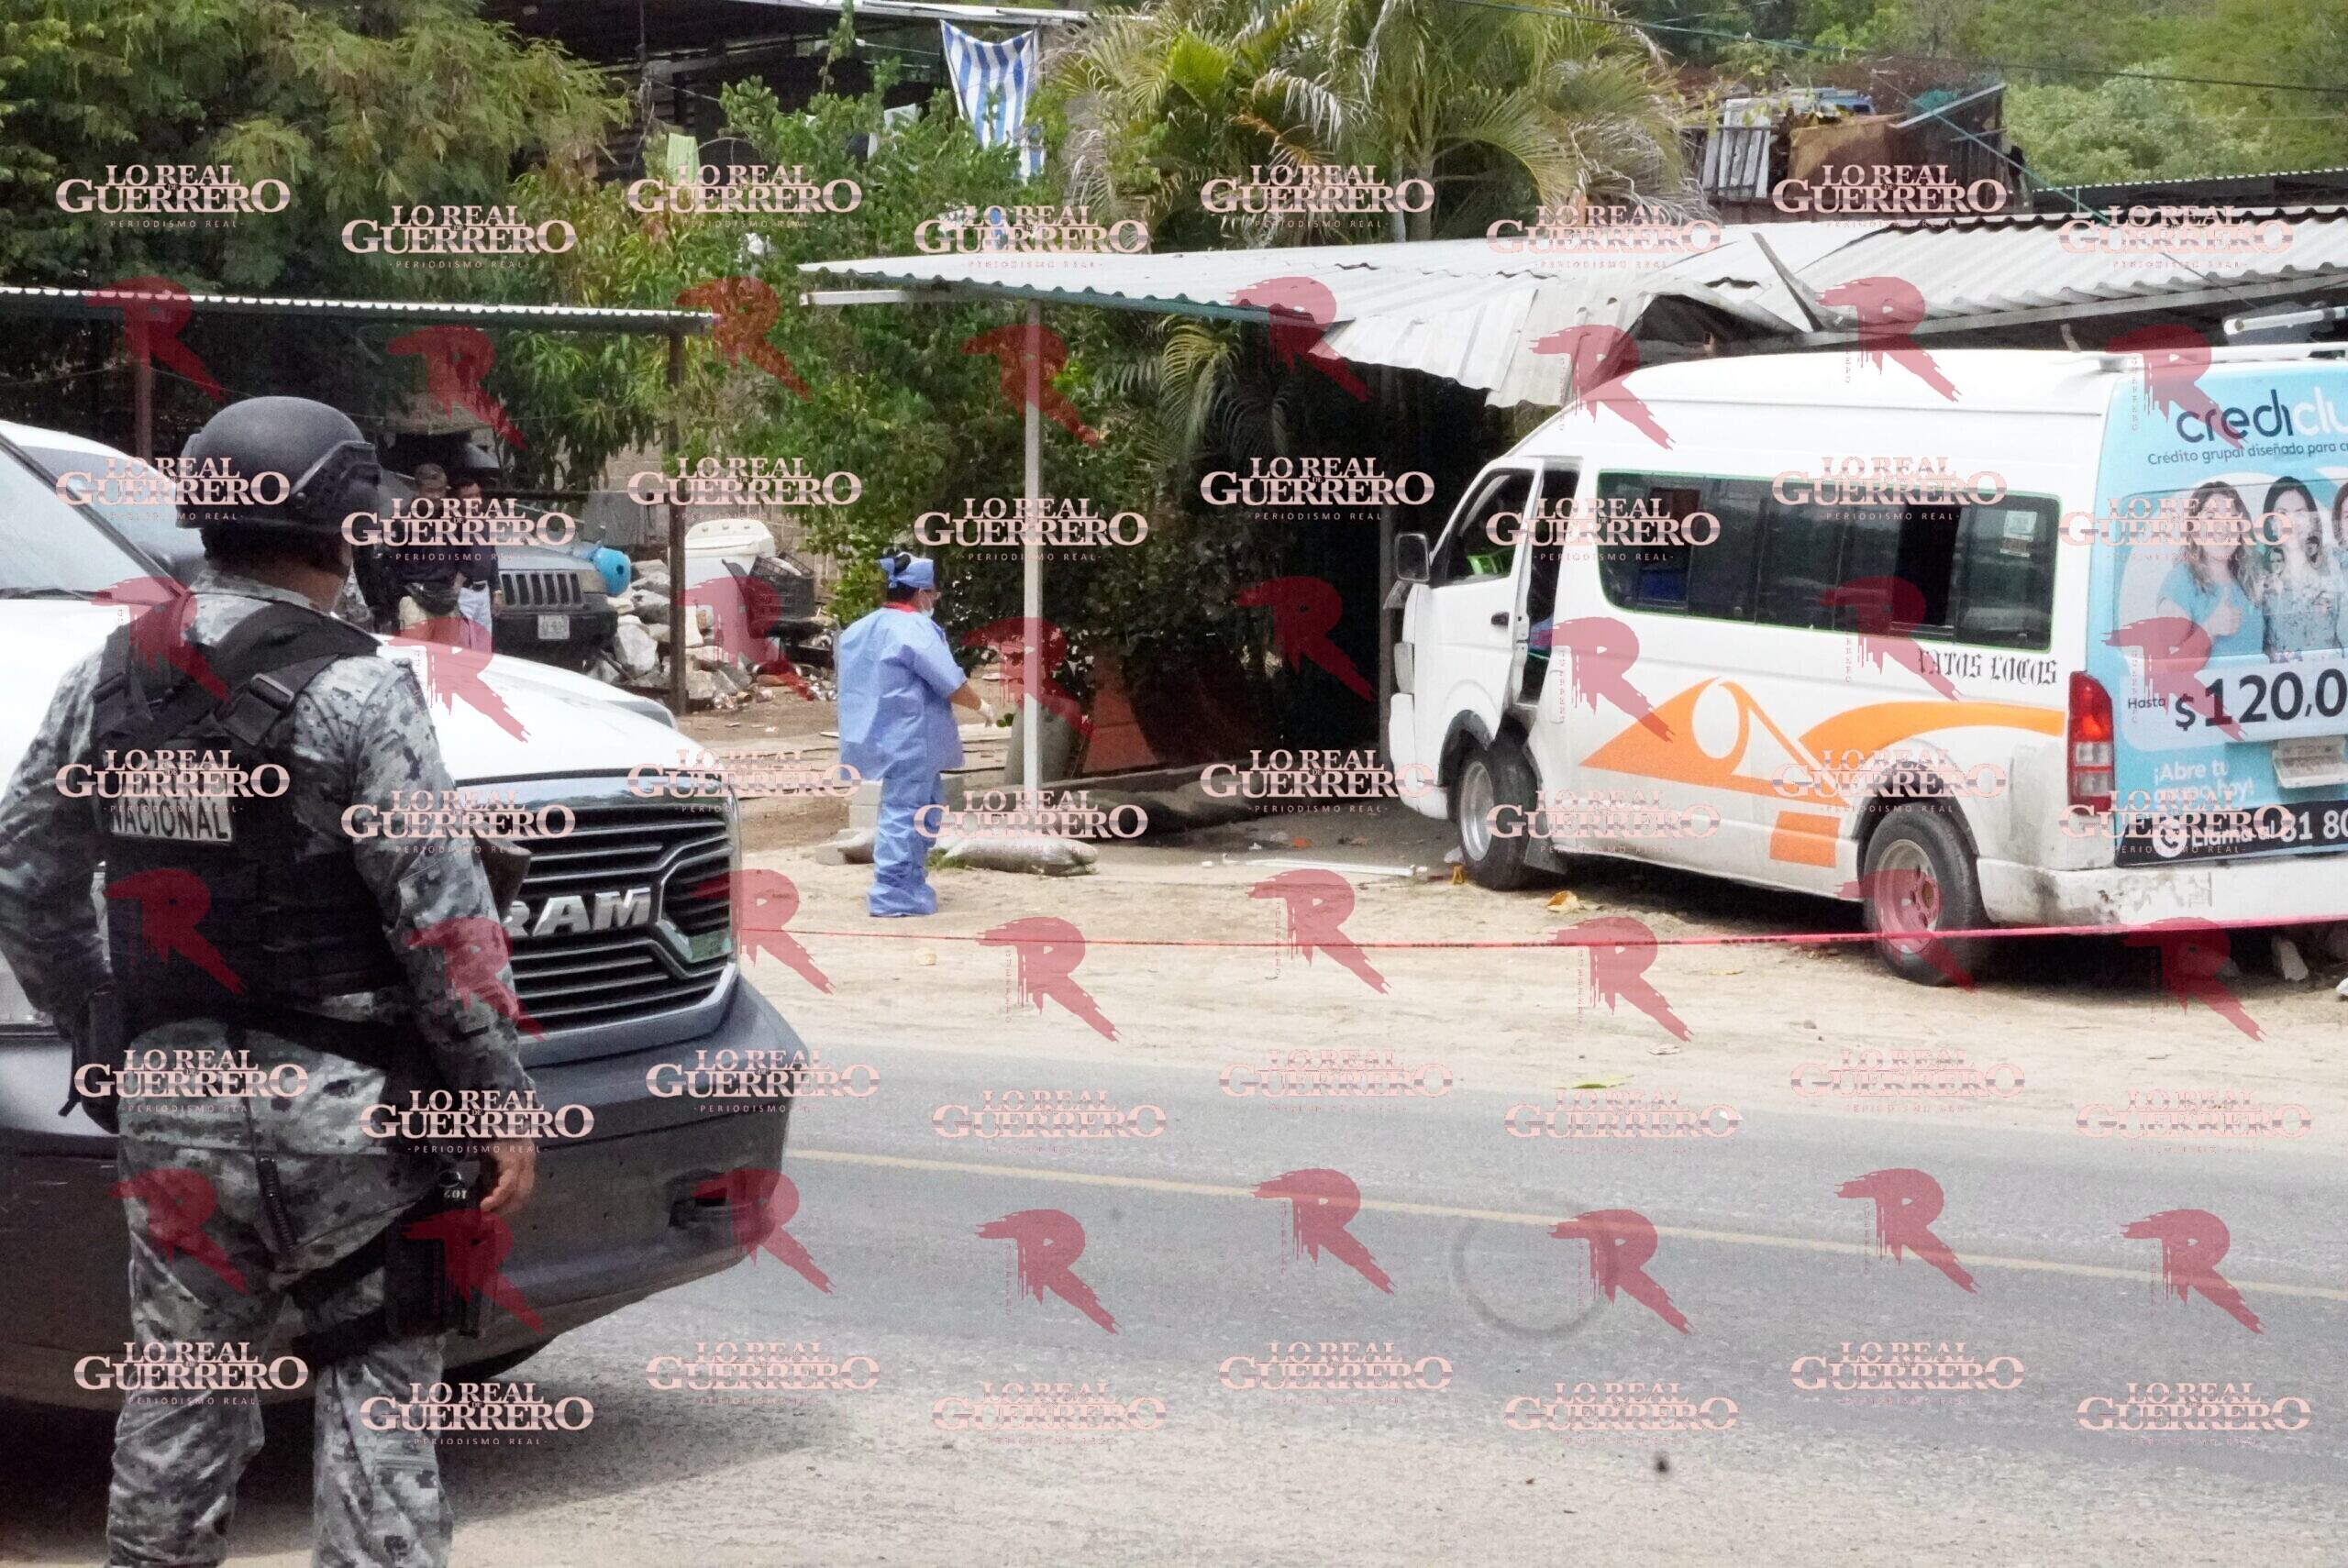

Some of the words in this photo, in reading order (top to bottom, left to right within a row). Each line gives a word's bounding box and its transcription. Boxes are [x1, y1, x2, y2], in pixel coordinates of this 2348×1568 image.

[2148, 449, 2198, 466] Crédito
[2202, 447, 2244, 465] grupal
[2248, 442, 2304, 458] diseñado
[2308, 445, 2335, 458] para
[2128, 697, 2165, 710] Hasta
[2211, 758, 2230, 778] tu
[113, 797, 229, 840] NACIONAL
[503, 887, 651, 938] RAM
